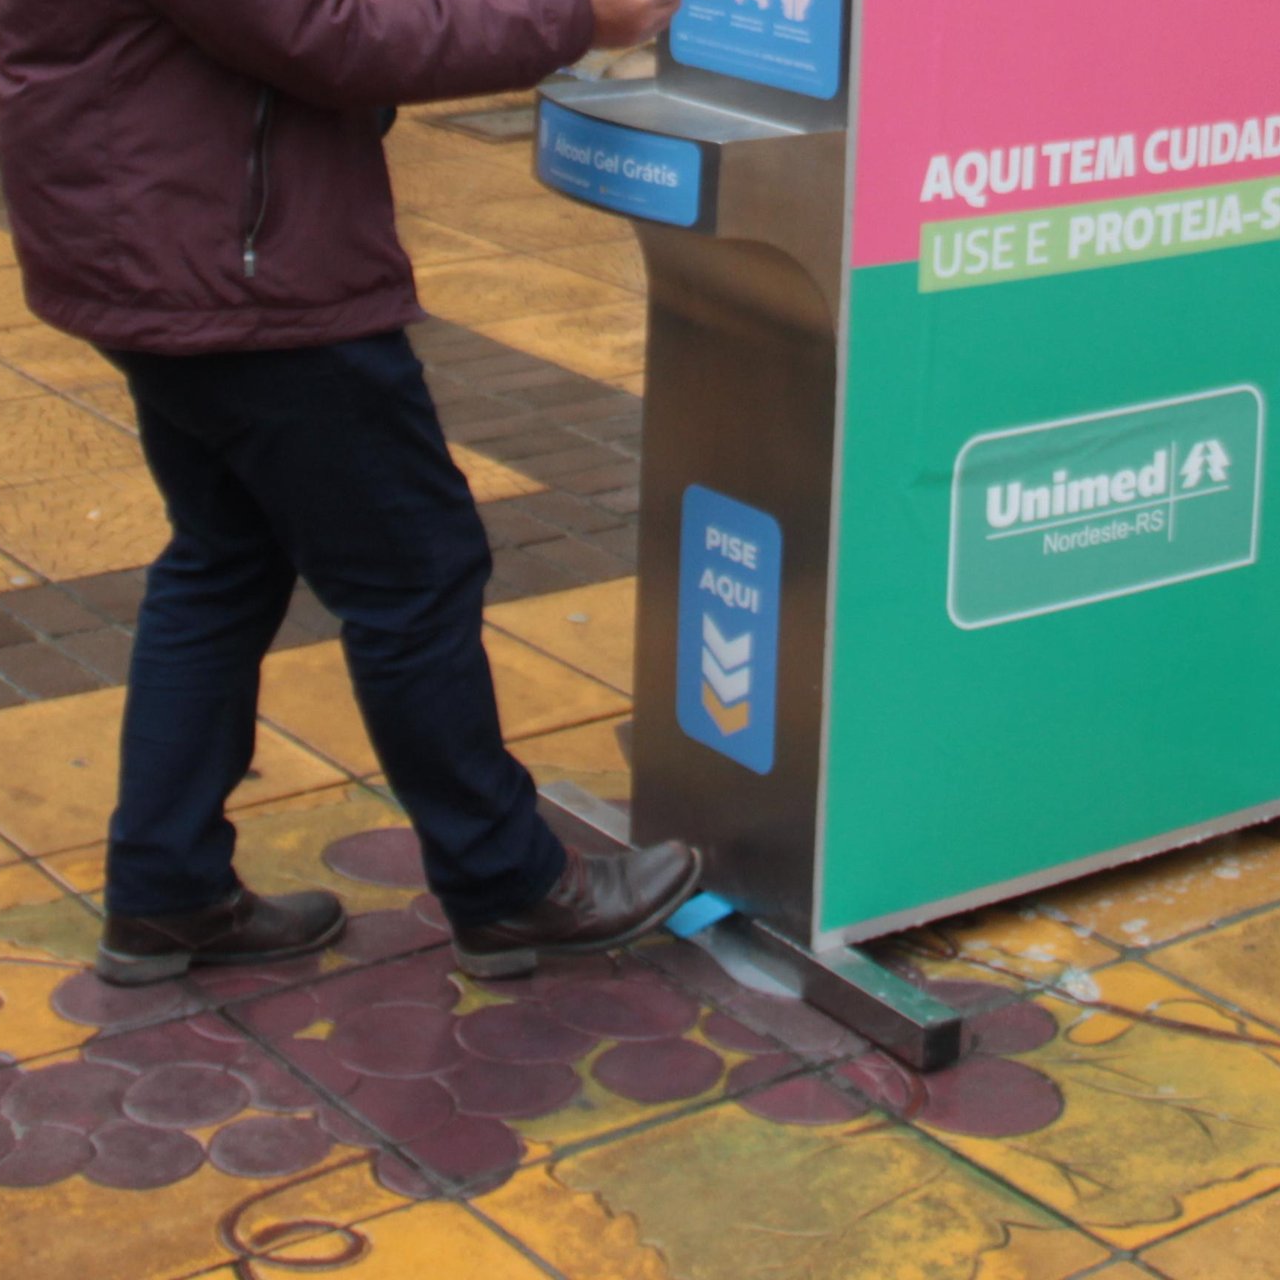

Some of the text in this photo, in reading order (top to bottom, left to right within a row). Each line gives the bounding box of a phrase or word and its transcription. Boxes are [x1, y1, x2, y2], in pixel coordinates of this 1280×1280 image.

[593, 150, 620, 175] Gel
[622, 159, 679, 188] Grátis
[919, 150, 1033, 208] AQUI
[1042, 134, 1137, 188] TEM
[930, 222, 1015, 278] USE
[1026, 220, 1049, 266] E
[985, 450, 1167, 528] Unimed
[704, 526, 759, 569] PISE
[1042, 509, 1165, 556] Nordeste-RS
[699, 567, 759, 613] AQUI
